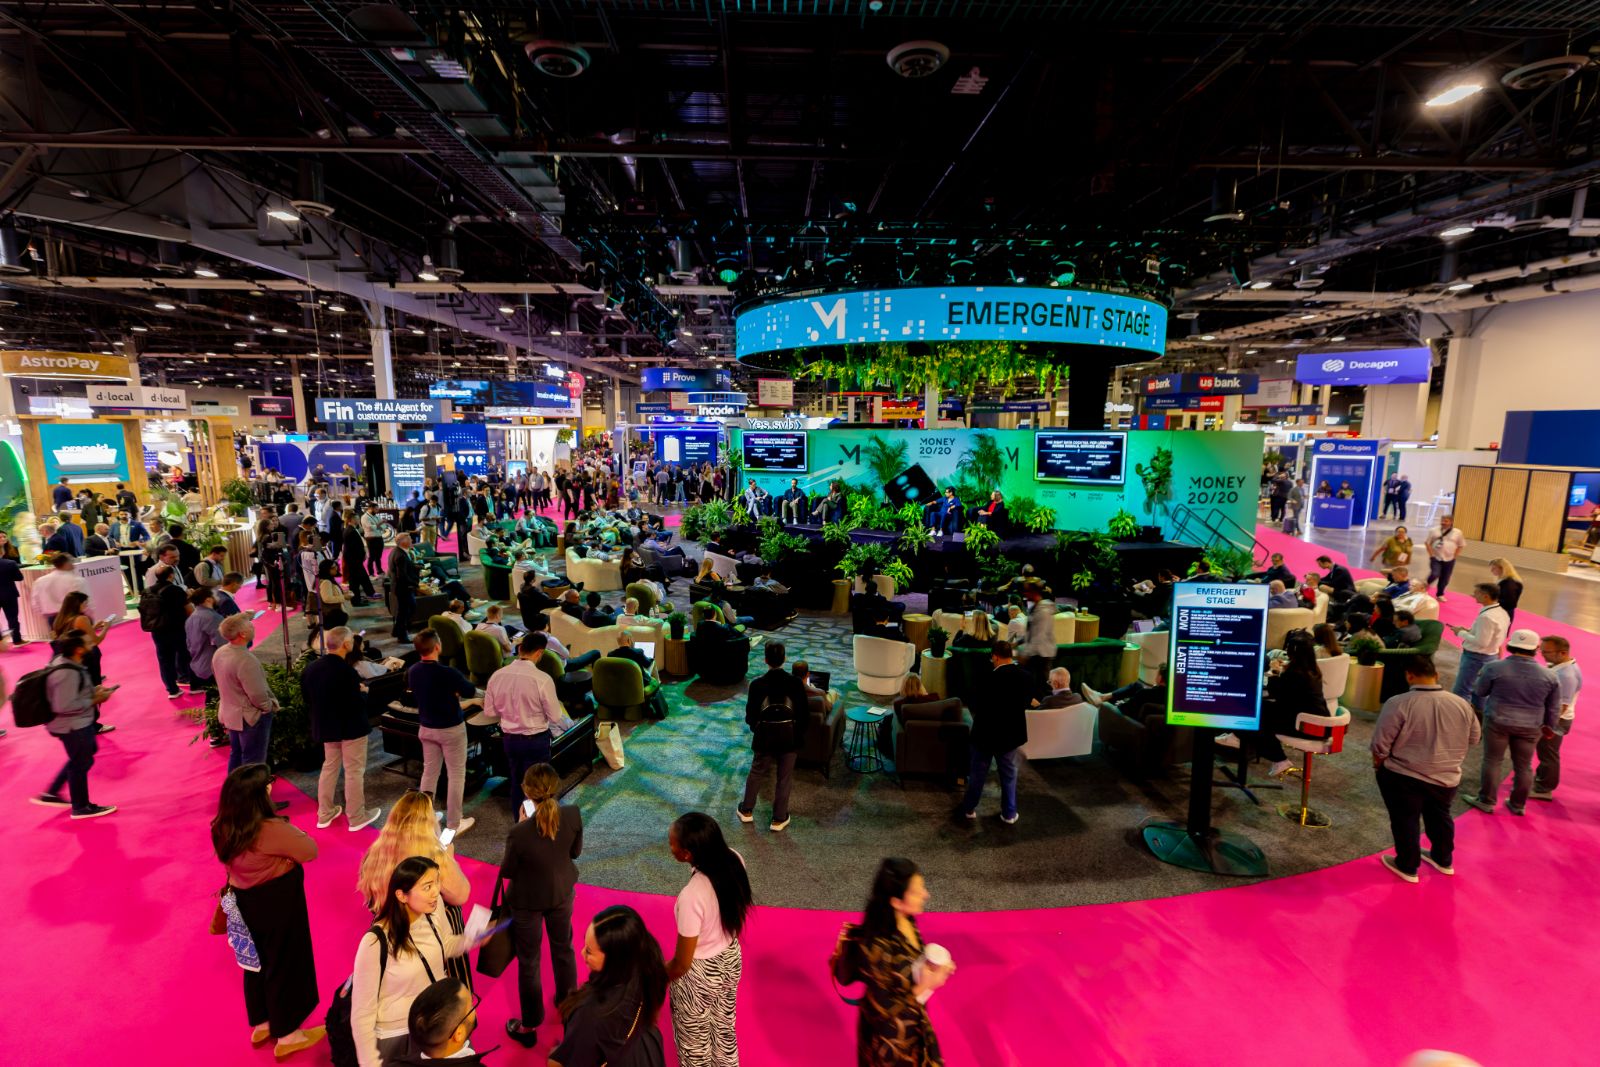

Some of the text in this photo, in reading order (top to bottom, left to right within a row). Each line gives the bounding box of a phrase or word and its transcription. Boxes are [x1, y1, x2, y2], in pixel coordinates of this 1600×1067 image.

[948, 301, 1151, 336] EMERGENT STAGE
[20, 355, 100, 371] AstroPay
[1349, 360, 1399, 369] Decagon
[672, 373, 696, 382] Prove
[1214, 377, 1241, 388] bank
[1155, 378, 1170, 389] bank
[323, 401, 354, 420] Fin
[356, 402, 433, 413] The #1 AI Agent for
[698, 405, 734, 416] incode
[357, 412, 427, 421] customer service
[920, 438, 956, 446] MONEY
[919, 447, 952, 455] 20/20
[1338, 444, 1371, 452] Decagon
[1189, 476, 1246, 489] MONEY
[1187, 491, 1239, 504] 20/20
[1196, 588, 1247, 596] EMERGENT
[1206, 597, 1236, 605] STAGE
[1178, 609, 1189, 631] NOW
[1176, 646, 1188, 674] LATER
